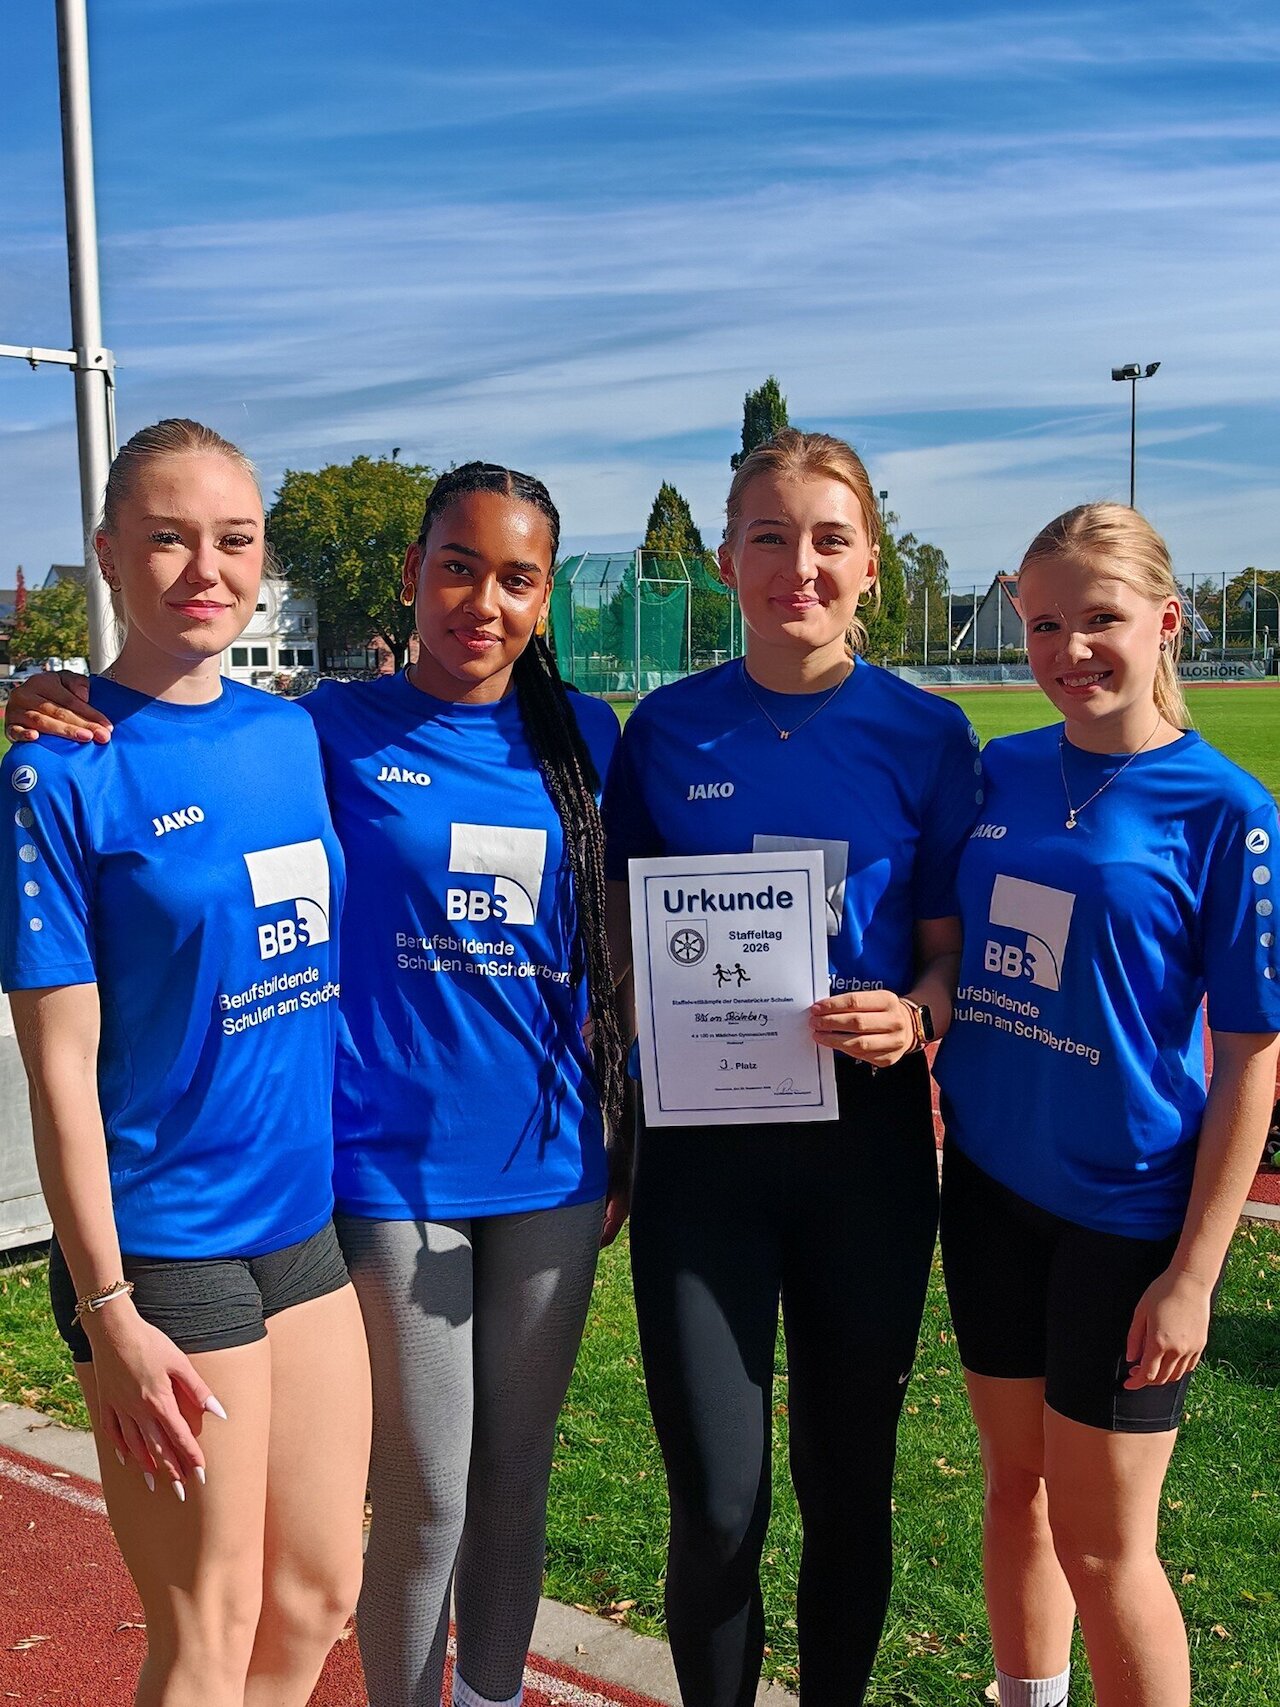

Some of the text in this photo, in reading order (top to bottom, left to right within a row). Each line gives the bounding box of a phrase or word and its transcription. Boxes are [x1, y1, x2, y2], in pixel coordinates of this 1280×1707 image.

[377, 766, 431, 786] JAKO
[687, 782, 734, 801] JAKO
[152, 805, 204, 837] JAKO
[447, 889, 508, 923] BBS
[663, 885, 793, 914] Urkunde
[258, 917, 310, 960] BBS
[396, 932, 515, 956] Berufsbildende
[728, 929, 783, 941] Staffeltag
[742, 943, 770, 953] 2026
[397, 954, 461, 972] Schulen
[984, 940, 1036, 982] BBS
[219, 966, 319, 1011] Berufsbildende
[957, 986, 1040, 1018] ufsbildende
[222, 1006, 275, 1035] Schulen
[277, 998, 299, 1015] am
[994, 1015, 1012, 1032] am
[1014, 1020, 1100, 1066] Schölerberg
[735, 1062, 757, 1070] Platz
